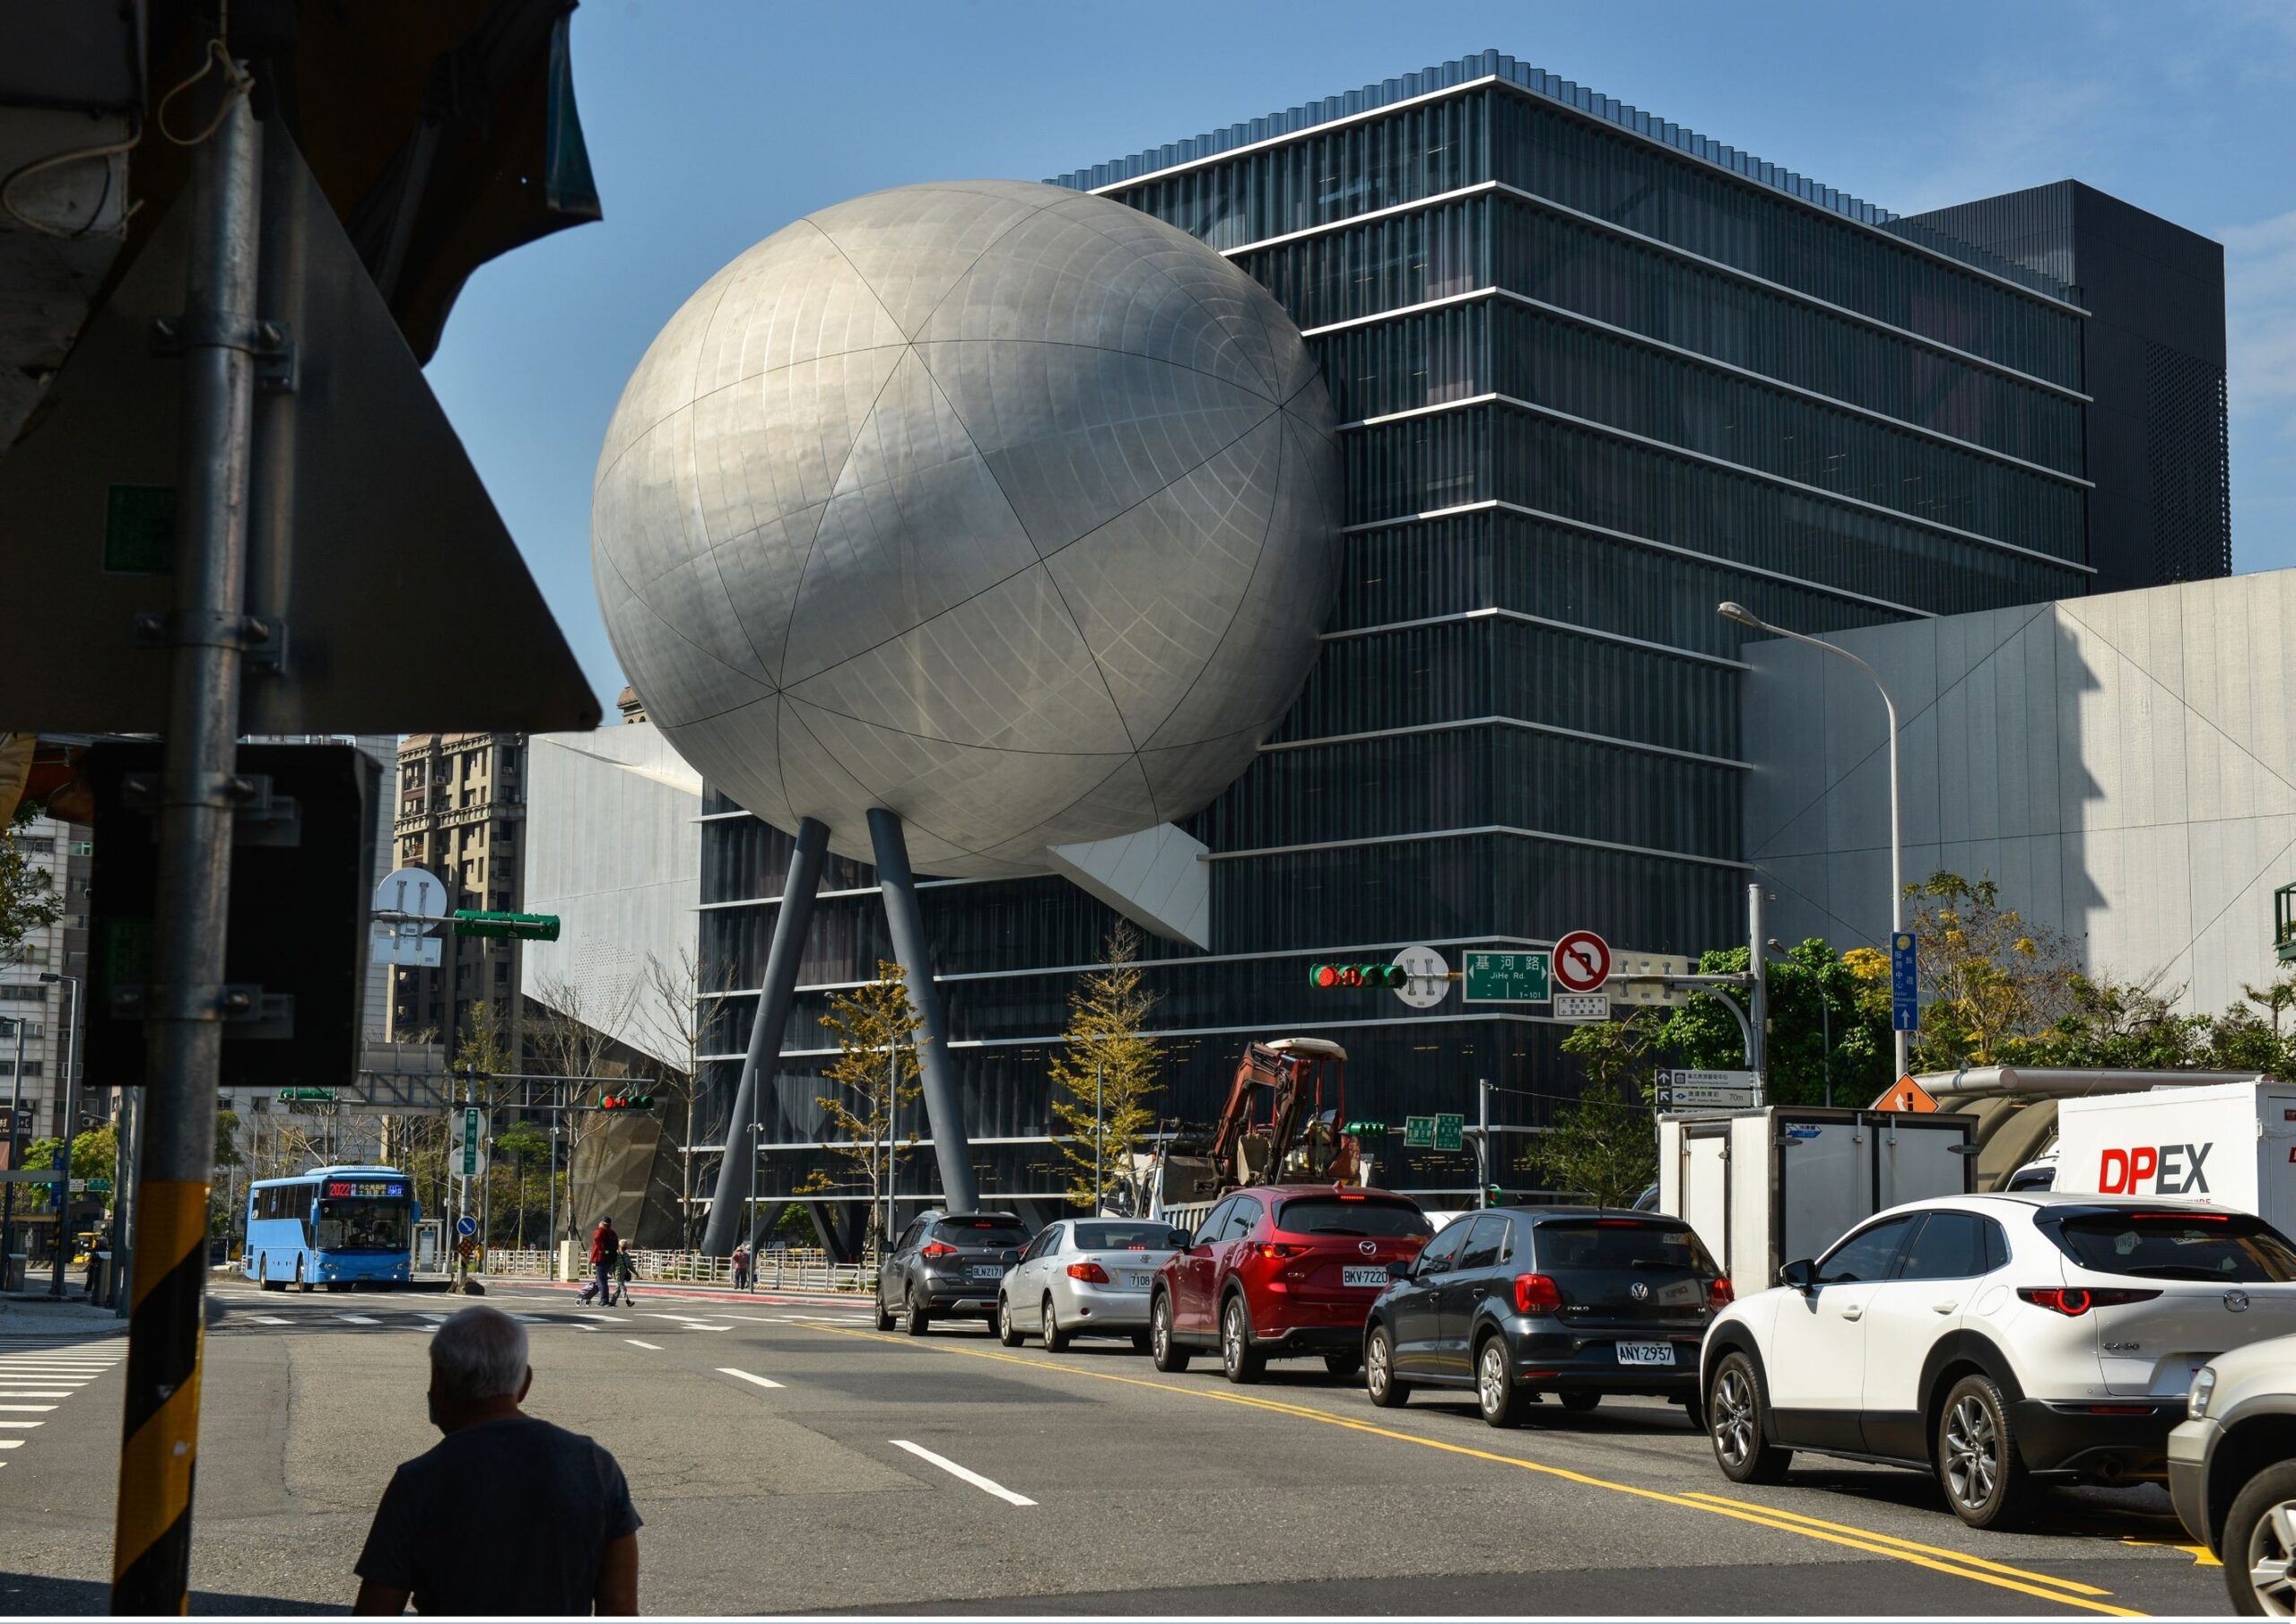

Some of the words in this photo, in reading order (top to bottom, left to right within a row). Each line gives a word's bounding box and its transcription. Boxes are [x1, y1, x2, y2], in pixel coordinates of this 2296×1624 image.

[1475, 955, 1540, 971] 基河路
[1490, 971, 1509, 979] JiHe
[1513, 971, 1526, 979] Rd.
[1519, 991, 1541, 999] 1-101
[1729, 1093, 1744, 1101] 70m
[2098, 1142, 2213, 1195] DPEX
[329, 1183, 350, 1196] 2022
[1619, 1346, 1673, 1361] ANY-2937
